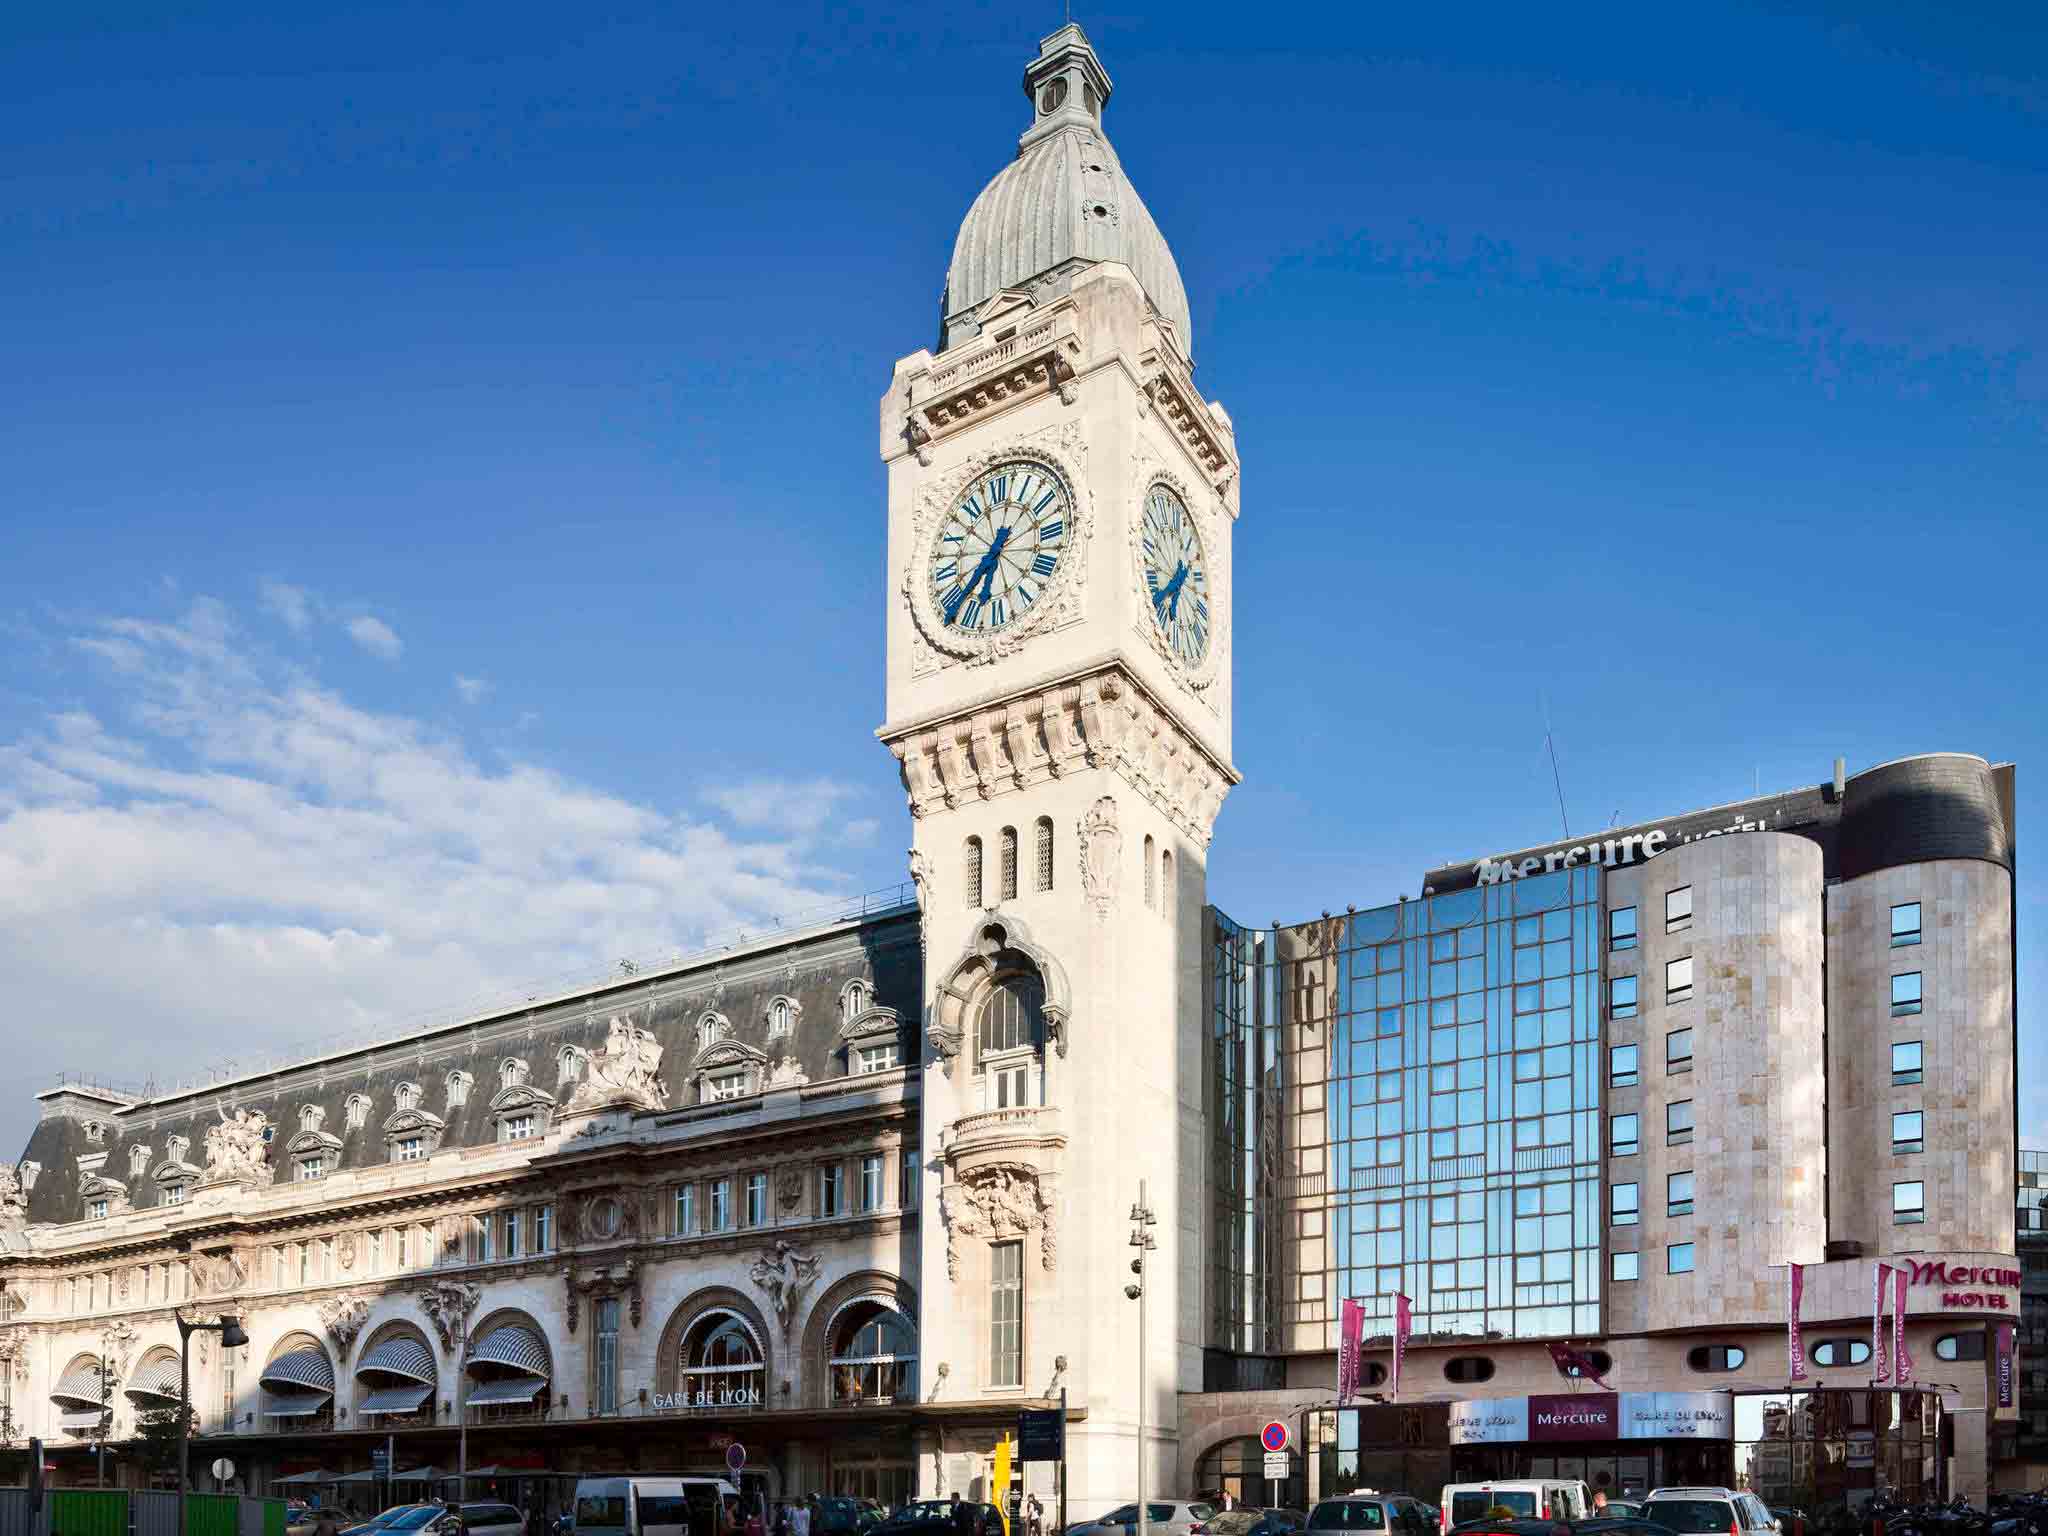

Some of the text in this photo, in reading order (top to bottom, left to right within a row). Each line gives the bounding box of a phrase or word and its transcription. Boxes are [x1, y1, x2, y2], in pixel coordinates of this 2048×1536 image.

[990, 476, 1007, 504] XII
[1017, 475, 1032, 501] I
[961, 496, 982, 519] XI
[1033, 490, 1056, 516] II
[944, 531, 965, 546] X
[1040, 520, 1063, 541] III
[936, 561, 957, 582] IX
[1031, 553, 1057, 577] IIII
[1018, 585, 1034, 607] V
[992, 600, 1005, 627] VI
[1473, 828, 1667, 887] Mercure
[1942, 1292, 2009, 1309] HOTEL
[2000, 1357, 2009, 1402] Mercure
[653, 1388, 760, 1407] GARE DE LYON
[1537, 1412, 1608, 1425] Mercure
